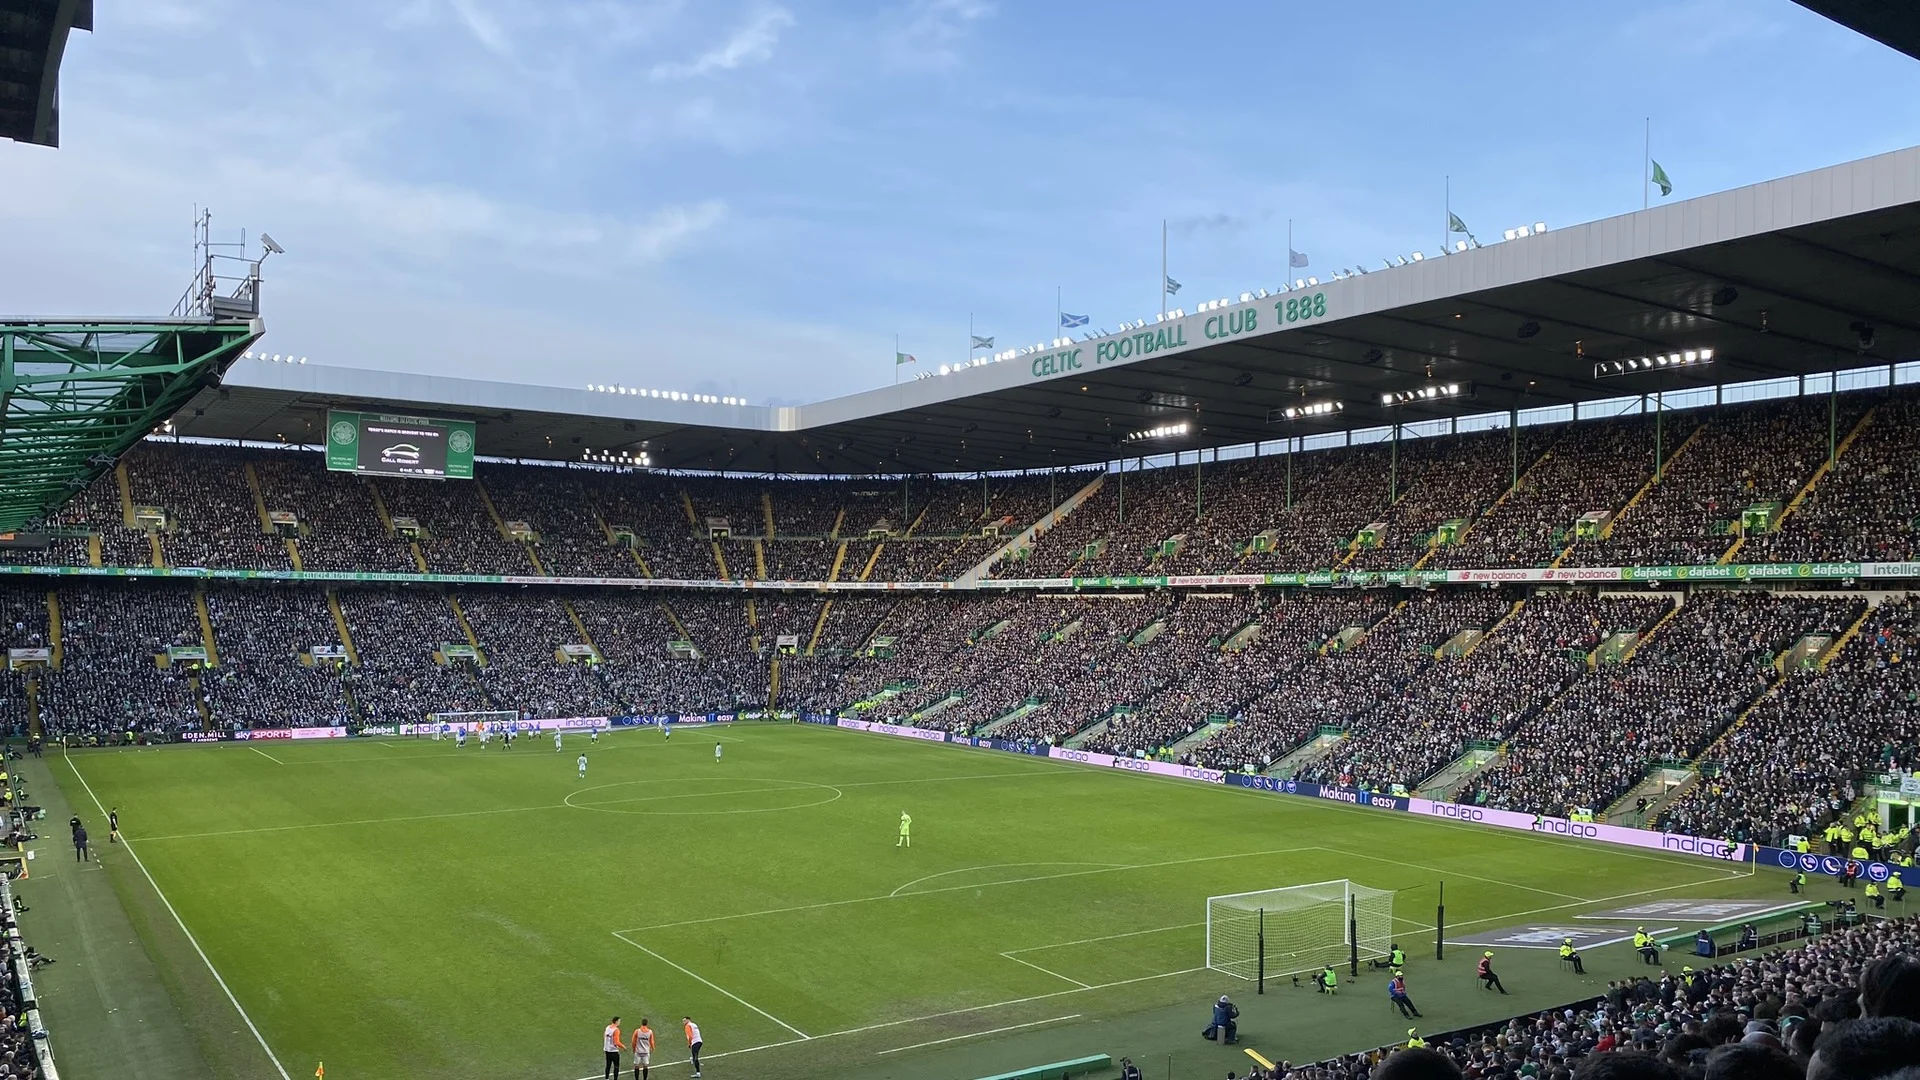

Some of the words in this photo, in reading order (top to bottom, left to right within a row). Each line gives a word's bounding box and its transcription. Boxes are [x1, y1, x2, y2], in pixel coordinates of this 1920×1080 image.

[1032, 348, 1082, 377] CELTIC
[1096, 324, 1187, 364] FOOTBALL
[1204, 308, 1257, 339] CLUB
[1274, 292, 1327, 325] 1888
[31, 565, 60, 574] dafabet
[79, 567, 107, 575] dafabet
[125, 567, 153, 576] dafabet
[171, 568, 198, 577] dafabet
[214, 569, 240, 577] dafabet
[1557, 571, 1576, 579] new
[1578, 569, 1617, 579] balance
[1634, 567, 1672, 578] dafabet
[1689, 566, 1730, 577] dafabet
[1748, 565, 1793, 577] dafabet
[1812, 564, 1860, 576] dafabet
[1189, 576, 1213, 584] balance
[1272, 575, 1296, 584] dafabet
[1305, 574, 1331, 583] dafabet
[1491, 571, 1527, 580] balance
[565, 717, 602, 727] indigo
[678, 712, 707, 723] Making
[235, 730, 250, 741] sky
[253, 729, 292, 739] SPORTS
[362, 725, 395, 735] dafabet
[951, 735, 971, 746] Making
[972, 736, 978, 745] IT
[979, 739, 992, 749] easy
[1057, 748, 1089, 762] indigo
[1182, 765, 1219, 782] indigo
[1319, 785, 1356, 804] Making
[1359, 791, 1369, 804] IT
[1371, 796, 1397, 810] easy
[1431, 801, 1483, 821] indigo
